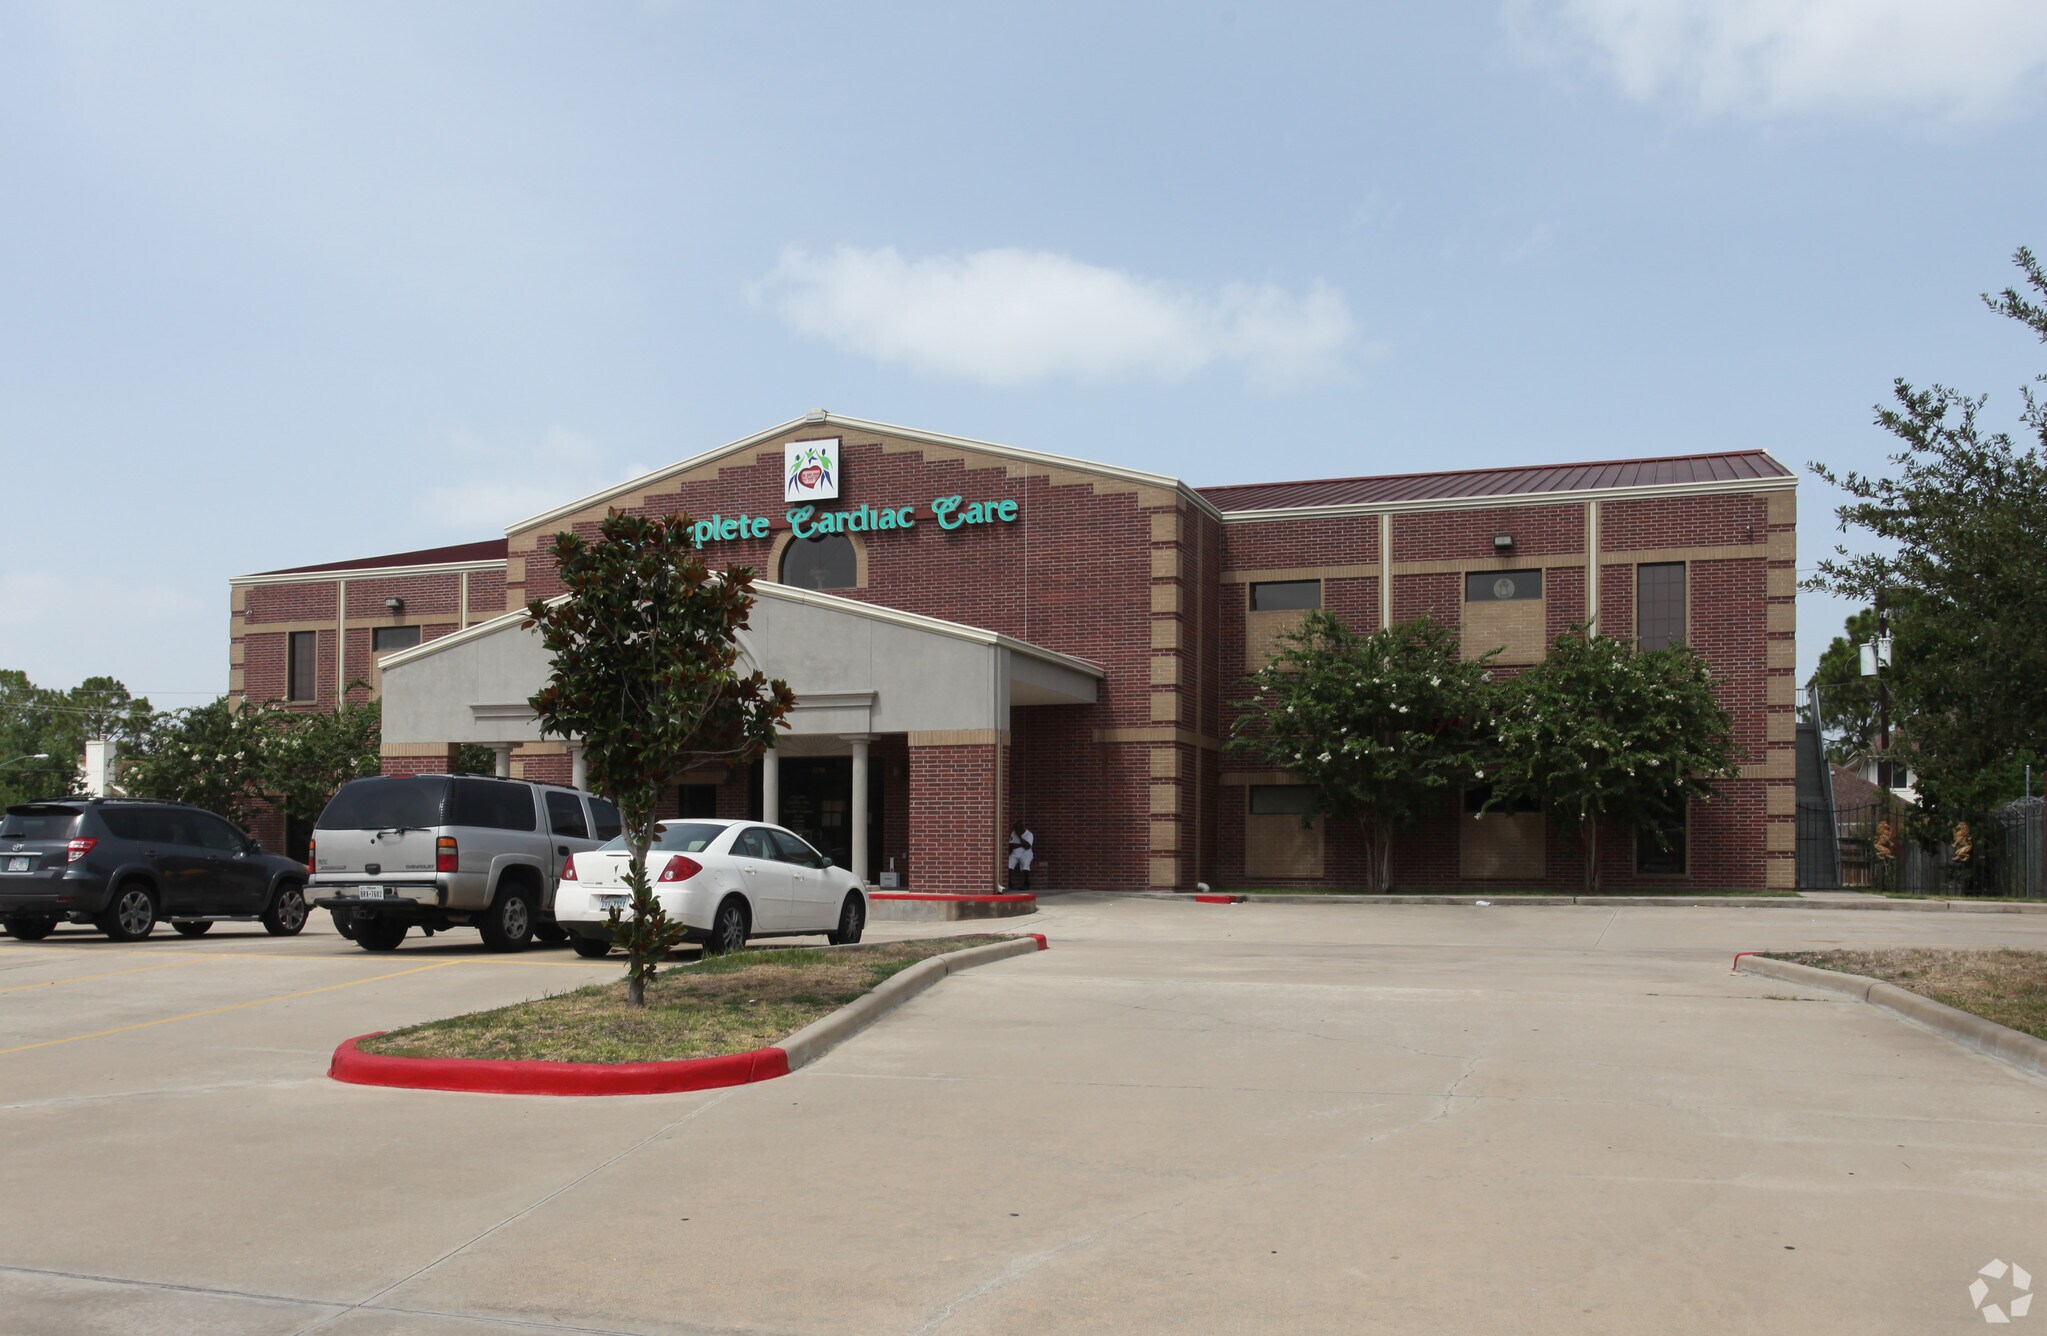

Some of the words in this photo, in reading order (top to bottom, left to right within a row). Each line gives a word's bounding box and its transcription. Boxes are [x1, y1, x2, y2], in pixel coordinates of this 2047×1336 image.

[667, 513, 770, 549] plete
[786, 504, 915, 539] Cardiac
[931, 495, 1018, 530] Care
